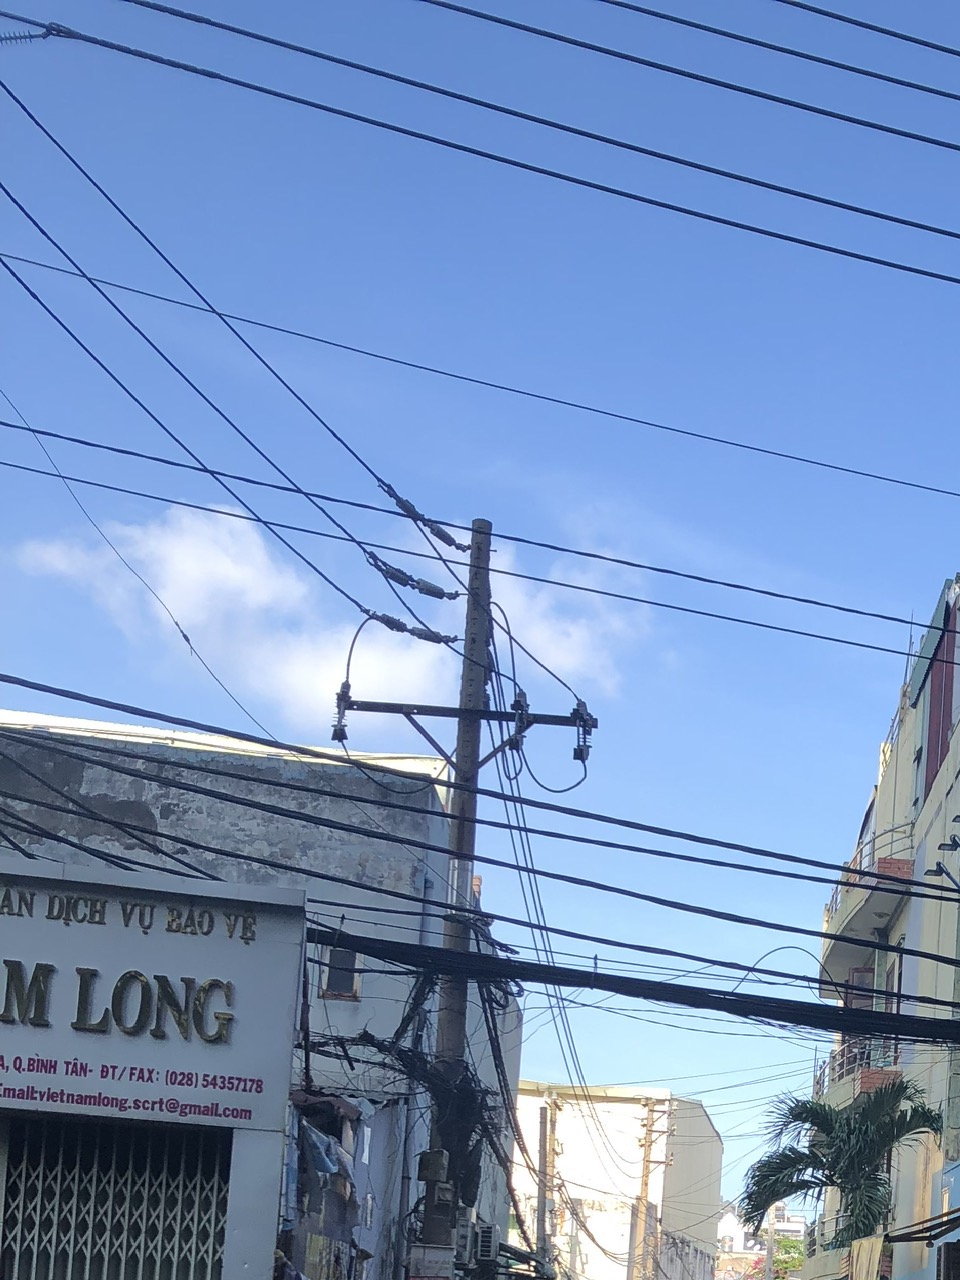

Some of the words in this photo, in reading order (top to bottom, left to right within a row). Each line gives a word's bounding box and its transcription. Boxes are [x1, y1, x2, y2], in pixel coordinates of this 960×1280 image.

[45, 893, 108, 926] DỊCH
[119, 900, 156, 935] VỤ
[0, 958, 58, 1028] M
[71, 966, 236, 1044] LONG
[165, 1069, 199, 1089] (028)
[201, 1073, 264, 1094] 54357178
